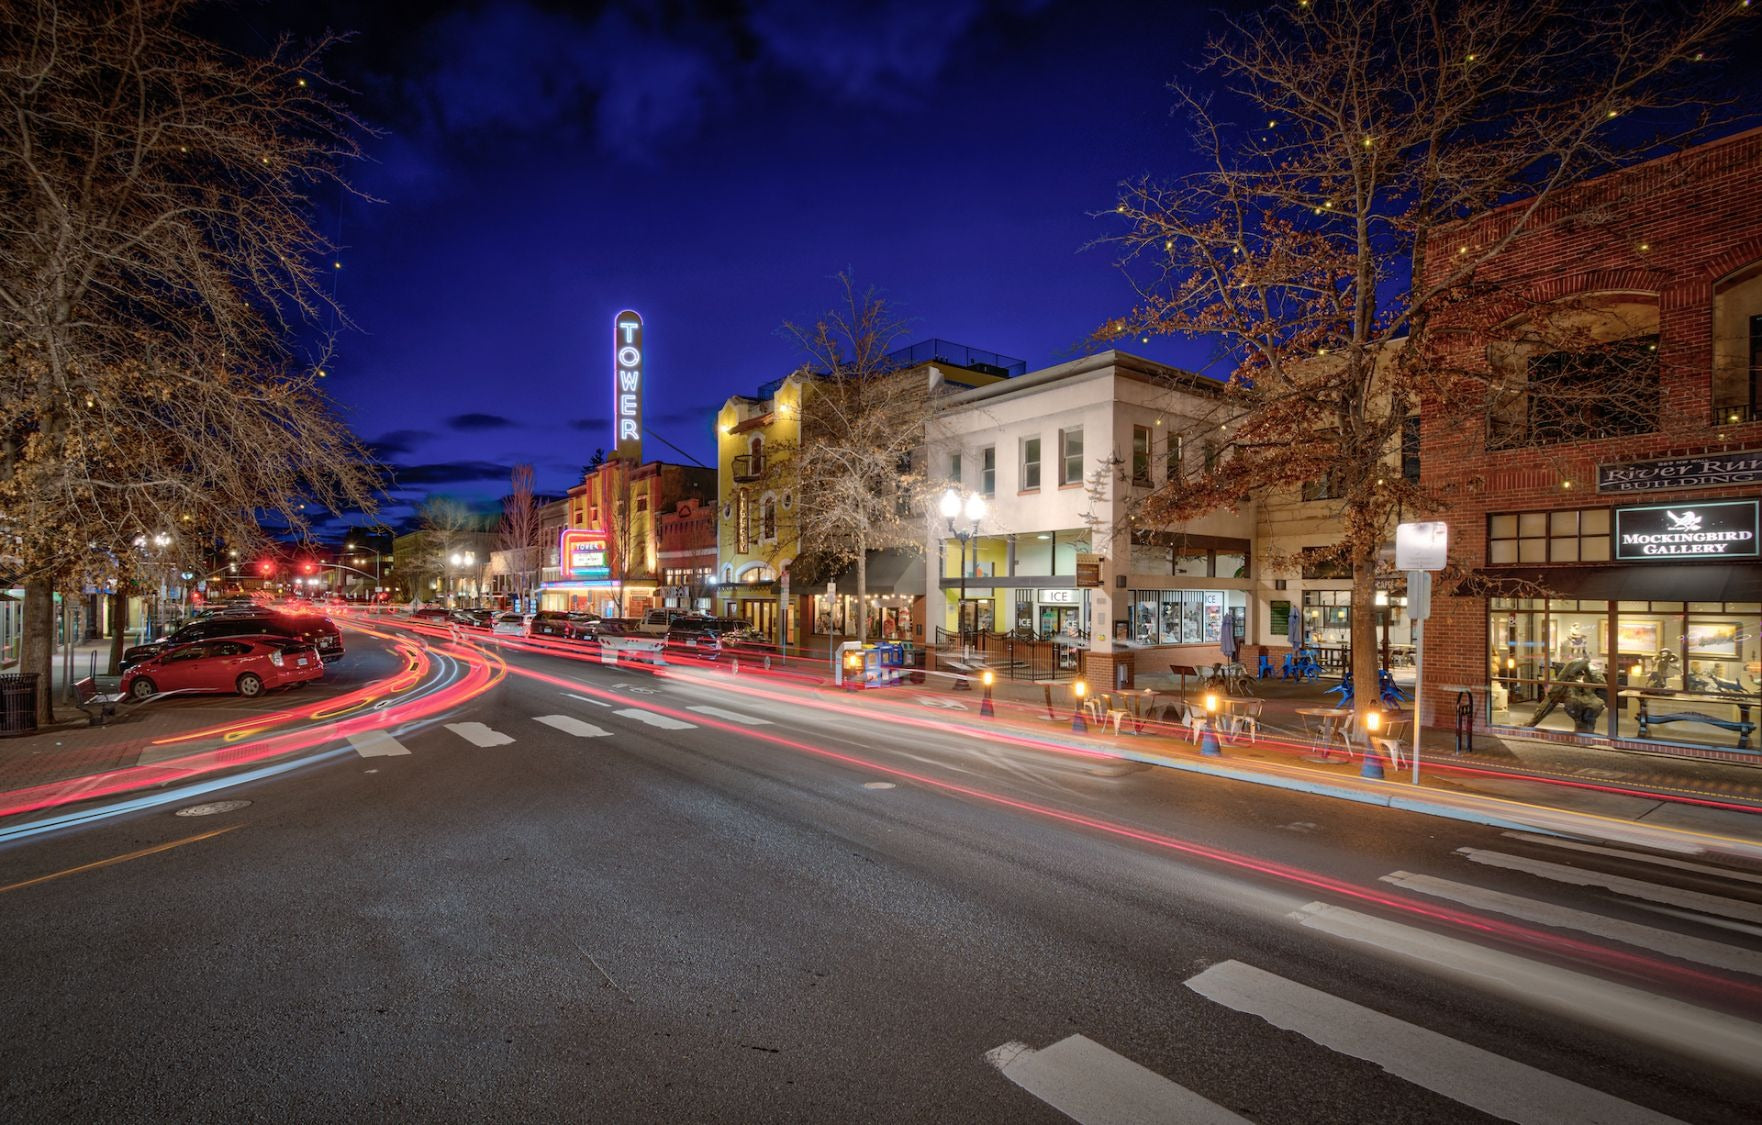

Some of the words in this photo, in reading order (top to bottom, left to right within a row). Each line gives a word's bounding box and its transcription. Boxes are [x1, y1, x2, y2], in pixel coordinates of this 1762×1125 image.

[618, 322, 640, 440] TOWER
[1604, 464, 1693, 482] River
[1620, 472, 1755, 491] BUILDING
[1050, 591, 1069, 602] ICE
[1018, 617, 1032, 627] ICE
